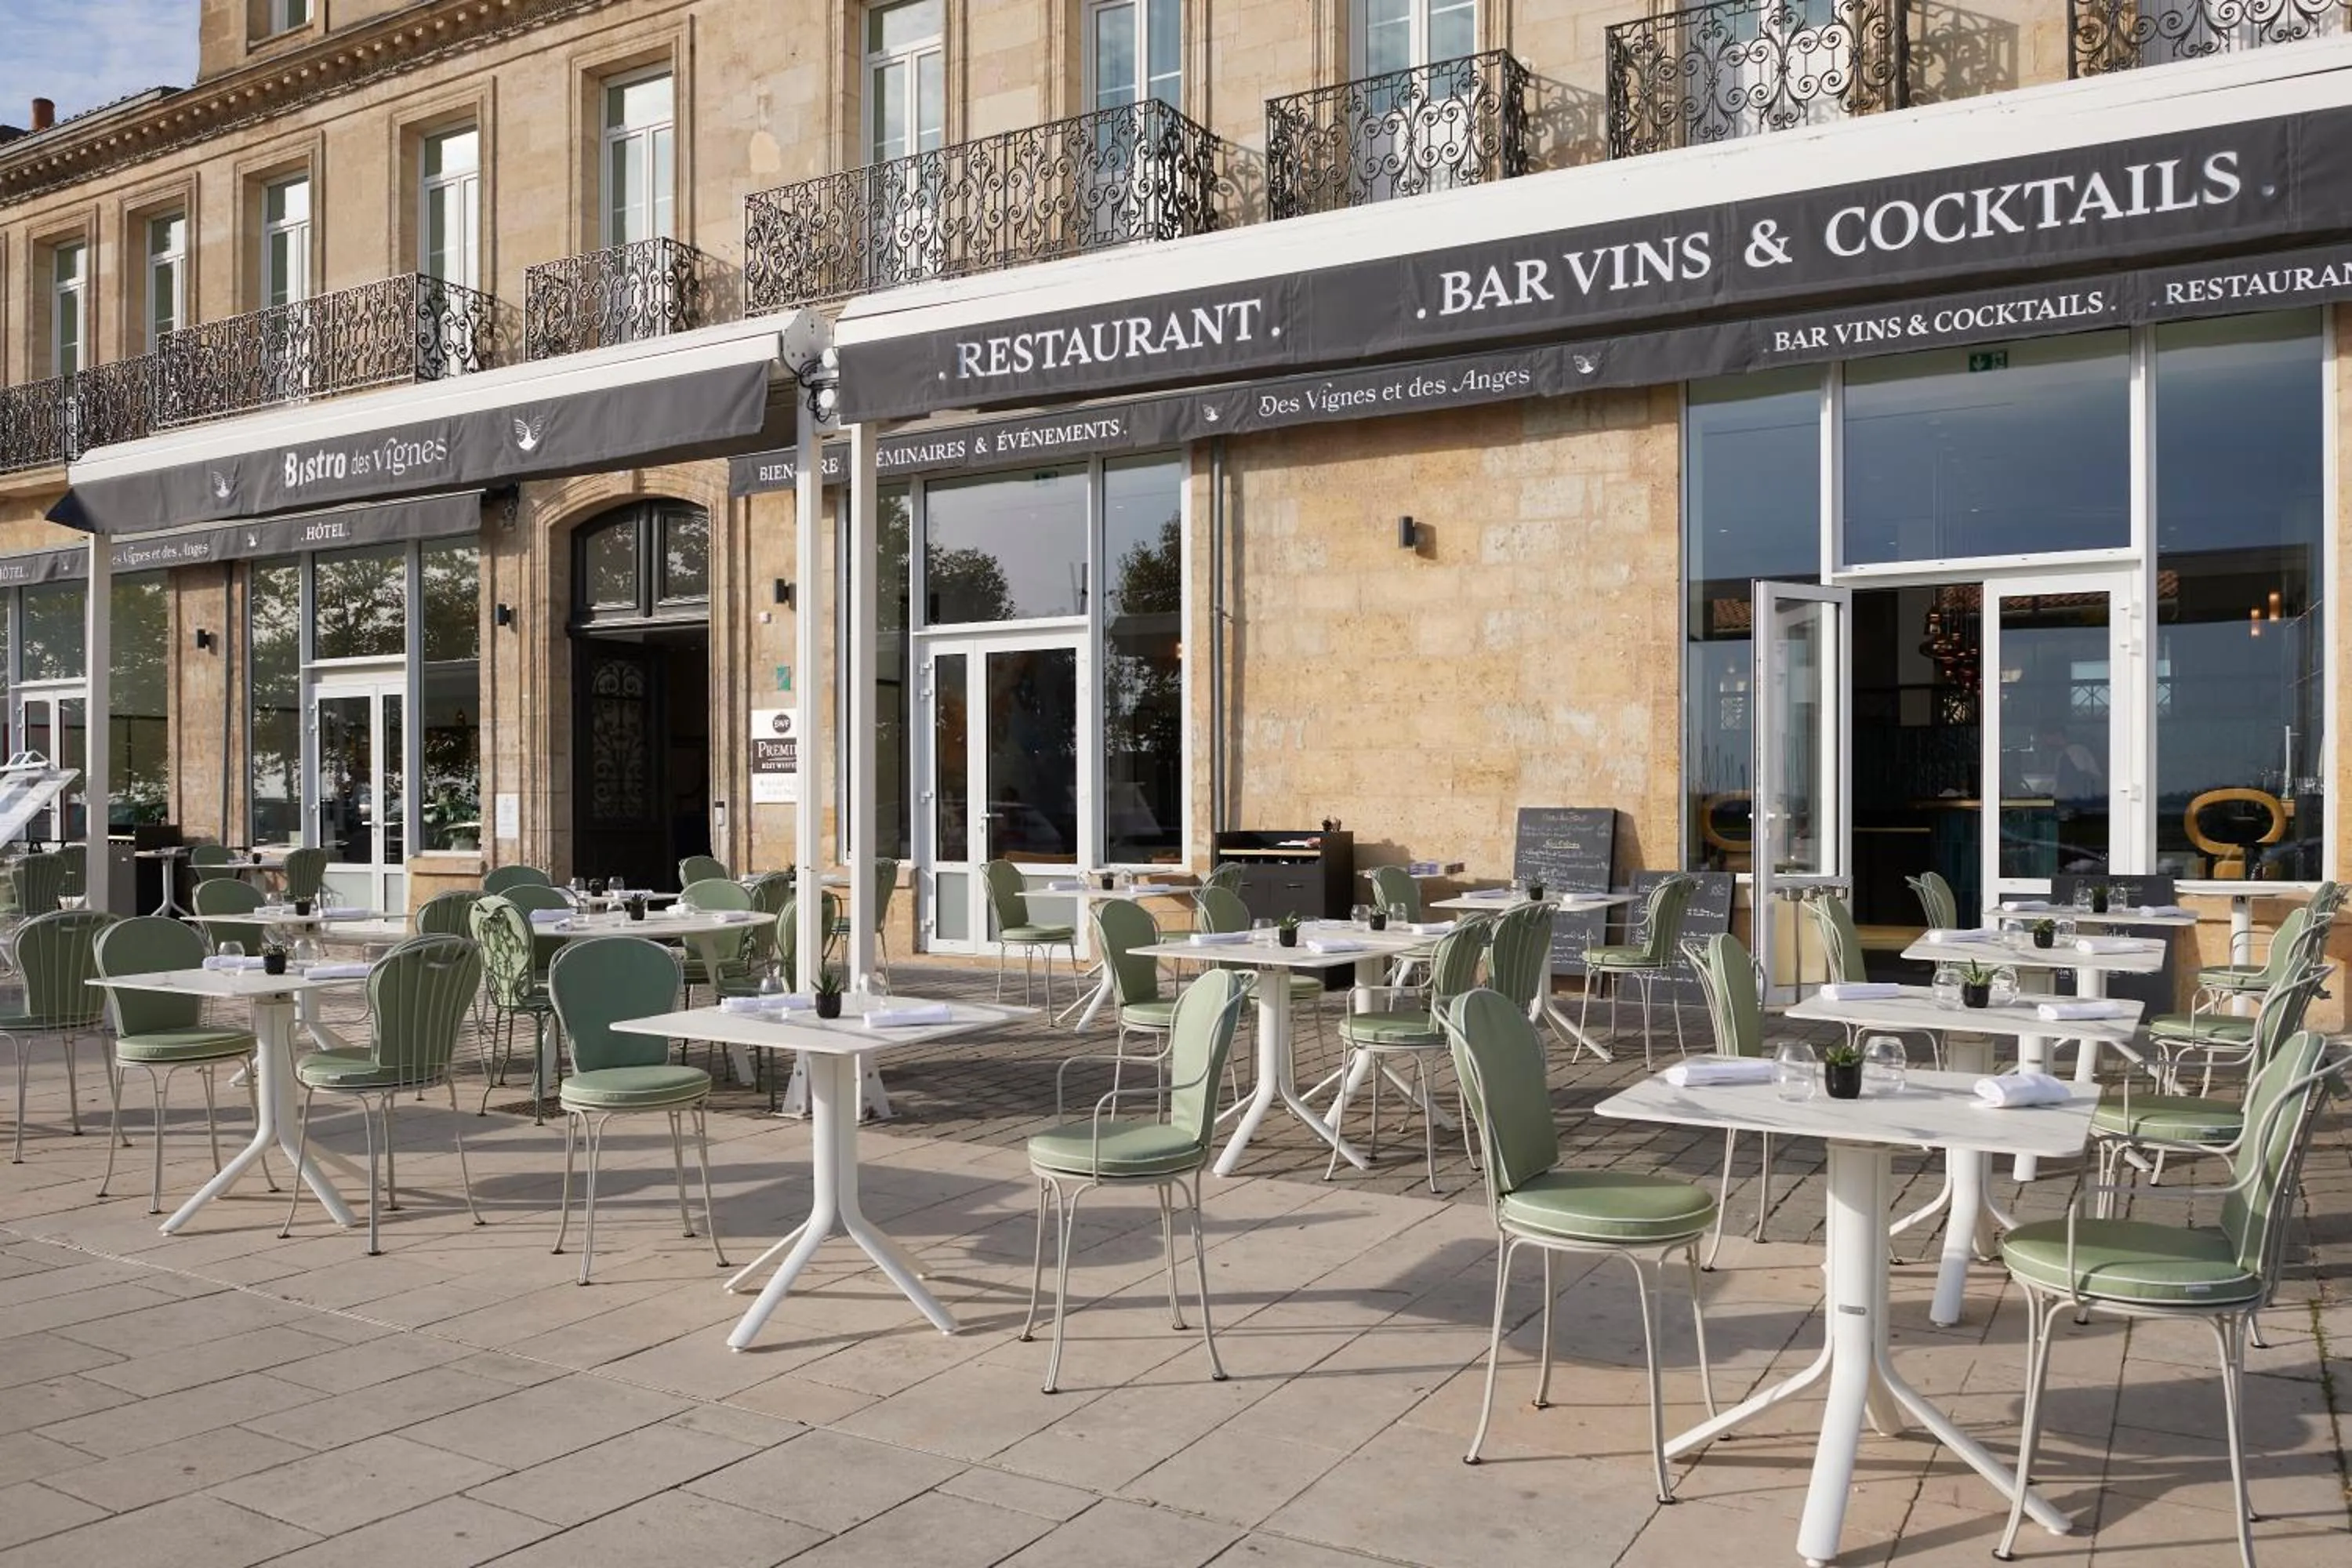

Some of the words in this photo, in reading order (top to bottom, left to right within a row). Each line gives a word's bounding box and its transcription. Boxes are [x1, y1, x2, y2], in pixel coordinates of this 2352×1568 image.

[1439, 258, 1554, 318] BAR
[1563, 232, 1712, 296] VINS
[1744, 219, 1793, 268] &
[1824, 151, 2241, 258] COCKTAILS
[2165, 262, 2352, 305] RESTAURA
[956, 300, 1261, 379] RESTAURANT
[1774, 326, 1829, 352] BAR
[1833, 317, 1902, 345] VINS
[1907, 314, 1929, 336] &
[1933, 291, 2104, 333] COCKTAILS
[1258, 395, 1300, 417] Des
[1305, 382, 1376, 412] Vignes
[1382, 382, 1403, 401] et
[1408, 376, 1446, 398] des
[1451, 368, 1530, 392] Anges
[285, 450, 347, 488] Bistro
[351, 449, 371, 474] des
[372, 437, 448, 476] Vignes
[876, 440, 966, 467] ÉMINAIRES
[975, 437, 988, 455] &
[306, 522, 346, 540] HÔTEL
[758, 741, 797, 758] PREMI
